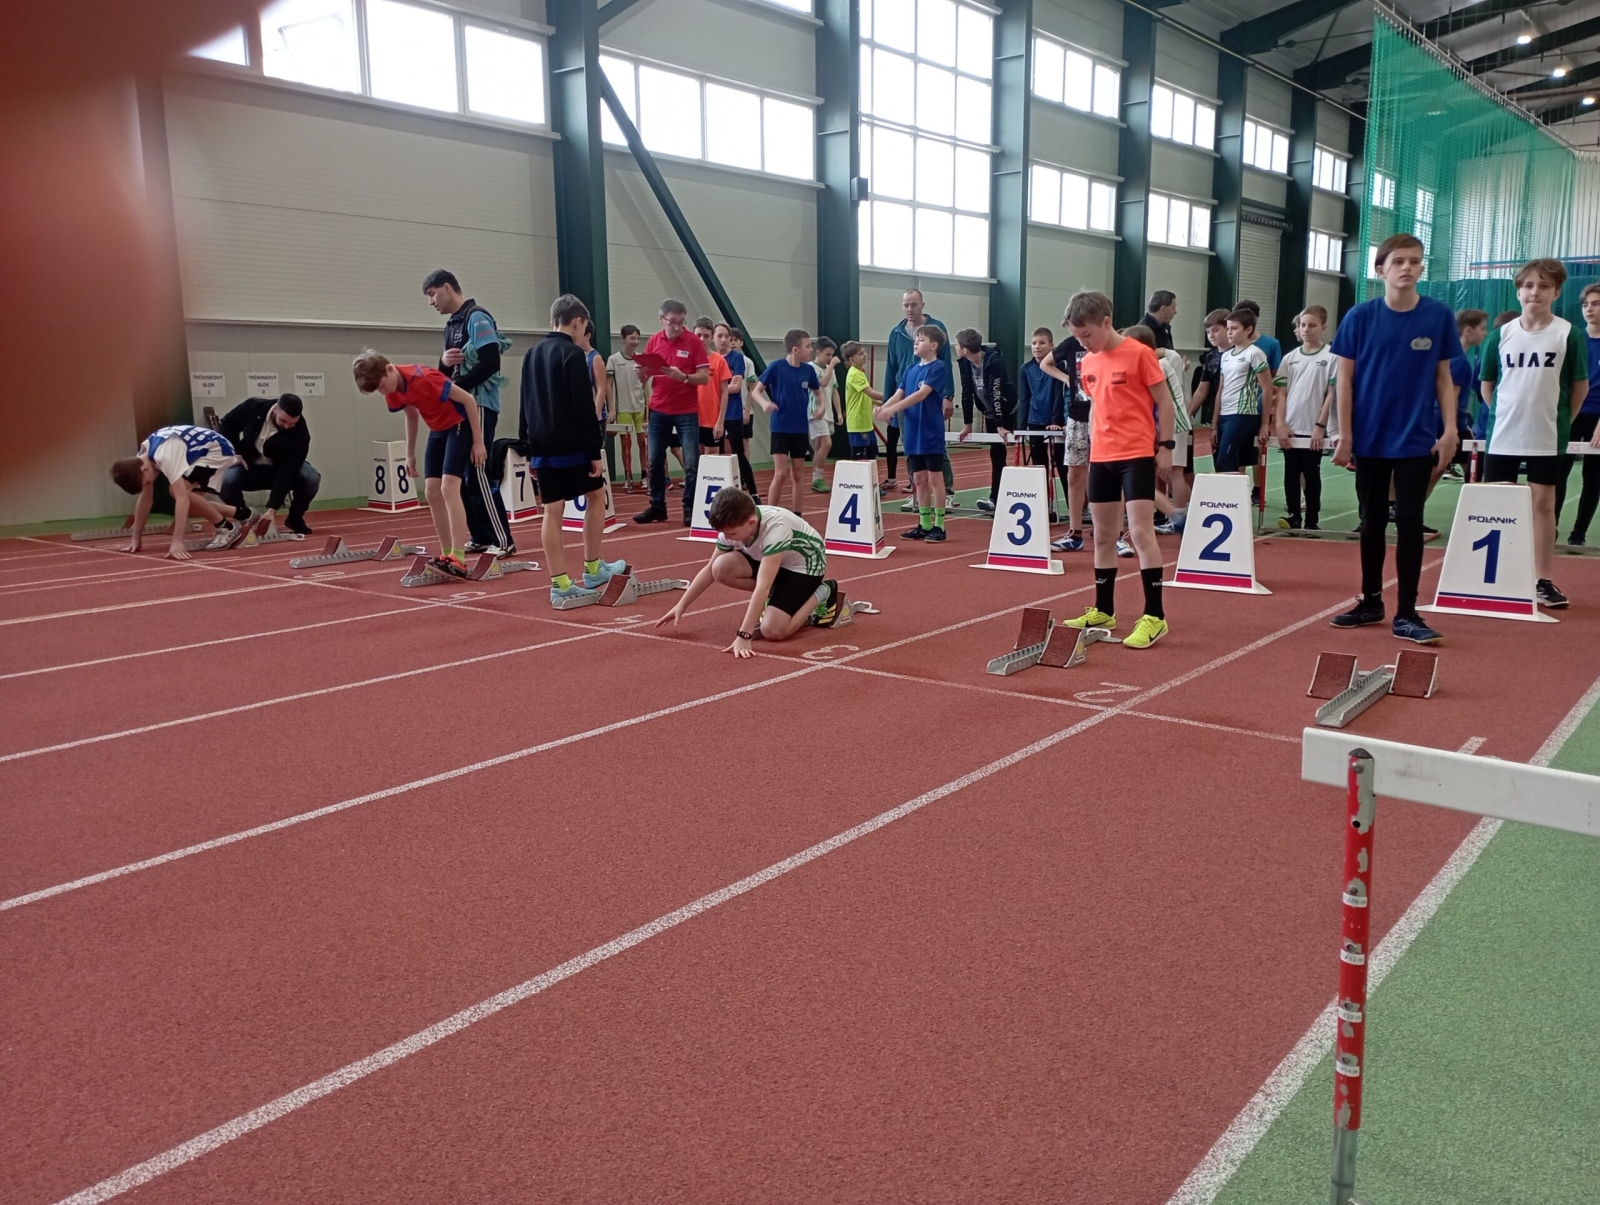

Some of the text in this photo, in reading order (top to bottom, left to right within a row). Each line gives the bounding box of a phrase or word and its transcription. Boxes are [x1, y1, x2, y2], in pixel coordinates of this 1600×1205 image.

[1506, 352, 1557, 368] LIAZ
[994, 401, 1003, 416] OUT
[375, 465, 386, 495] 8
[397, 465, 409, 494] 8
[515, 471, 526, 502] 7
[1006, 491, 1038, 499] POLANIK
[1200, 501, 1239, 510] POLANIK
[838, 493, 861, 533] 4
[1007, 502, 1032, 546] 3
[1468, 515, 1517, 525] POLANIK
[1198, 513, 1233, 562] 2
[1472, 529, 1501, 584] 1
